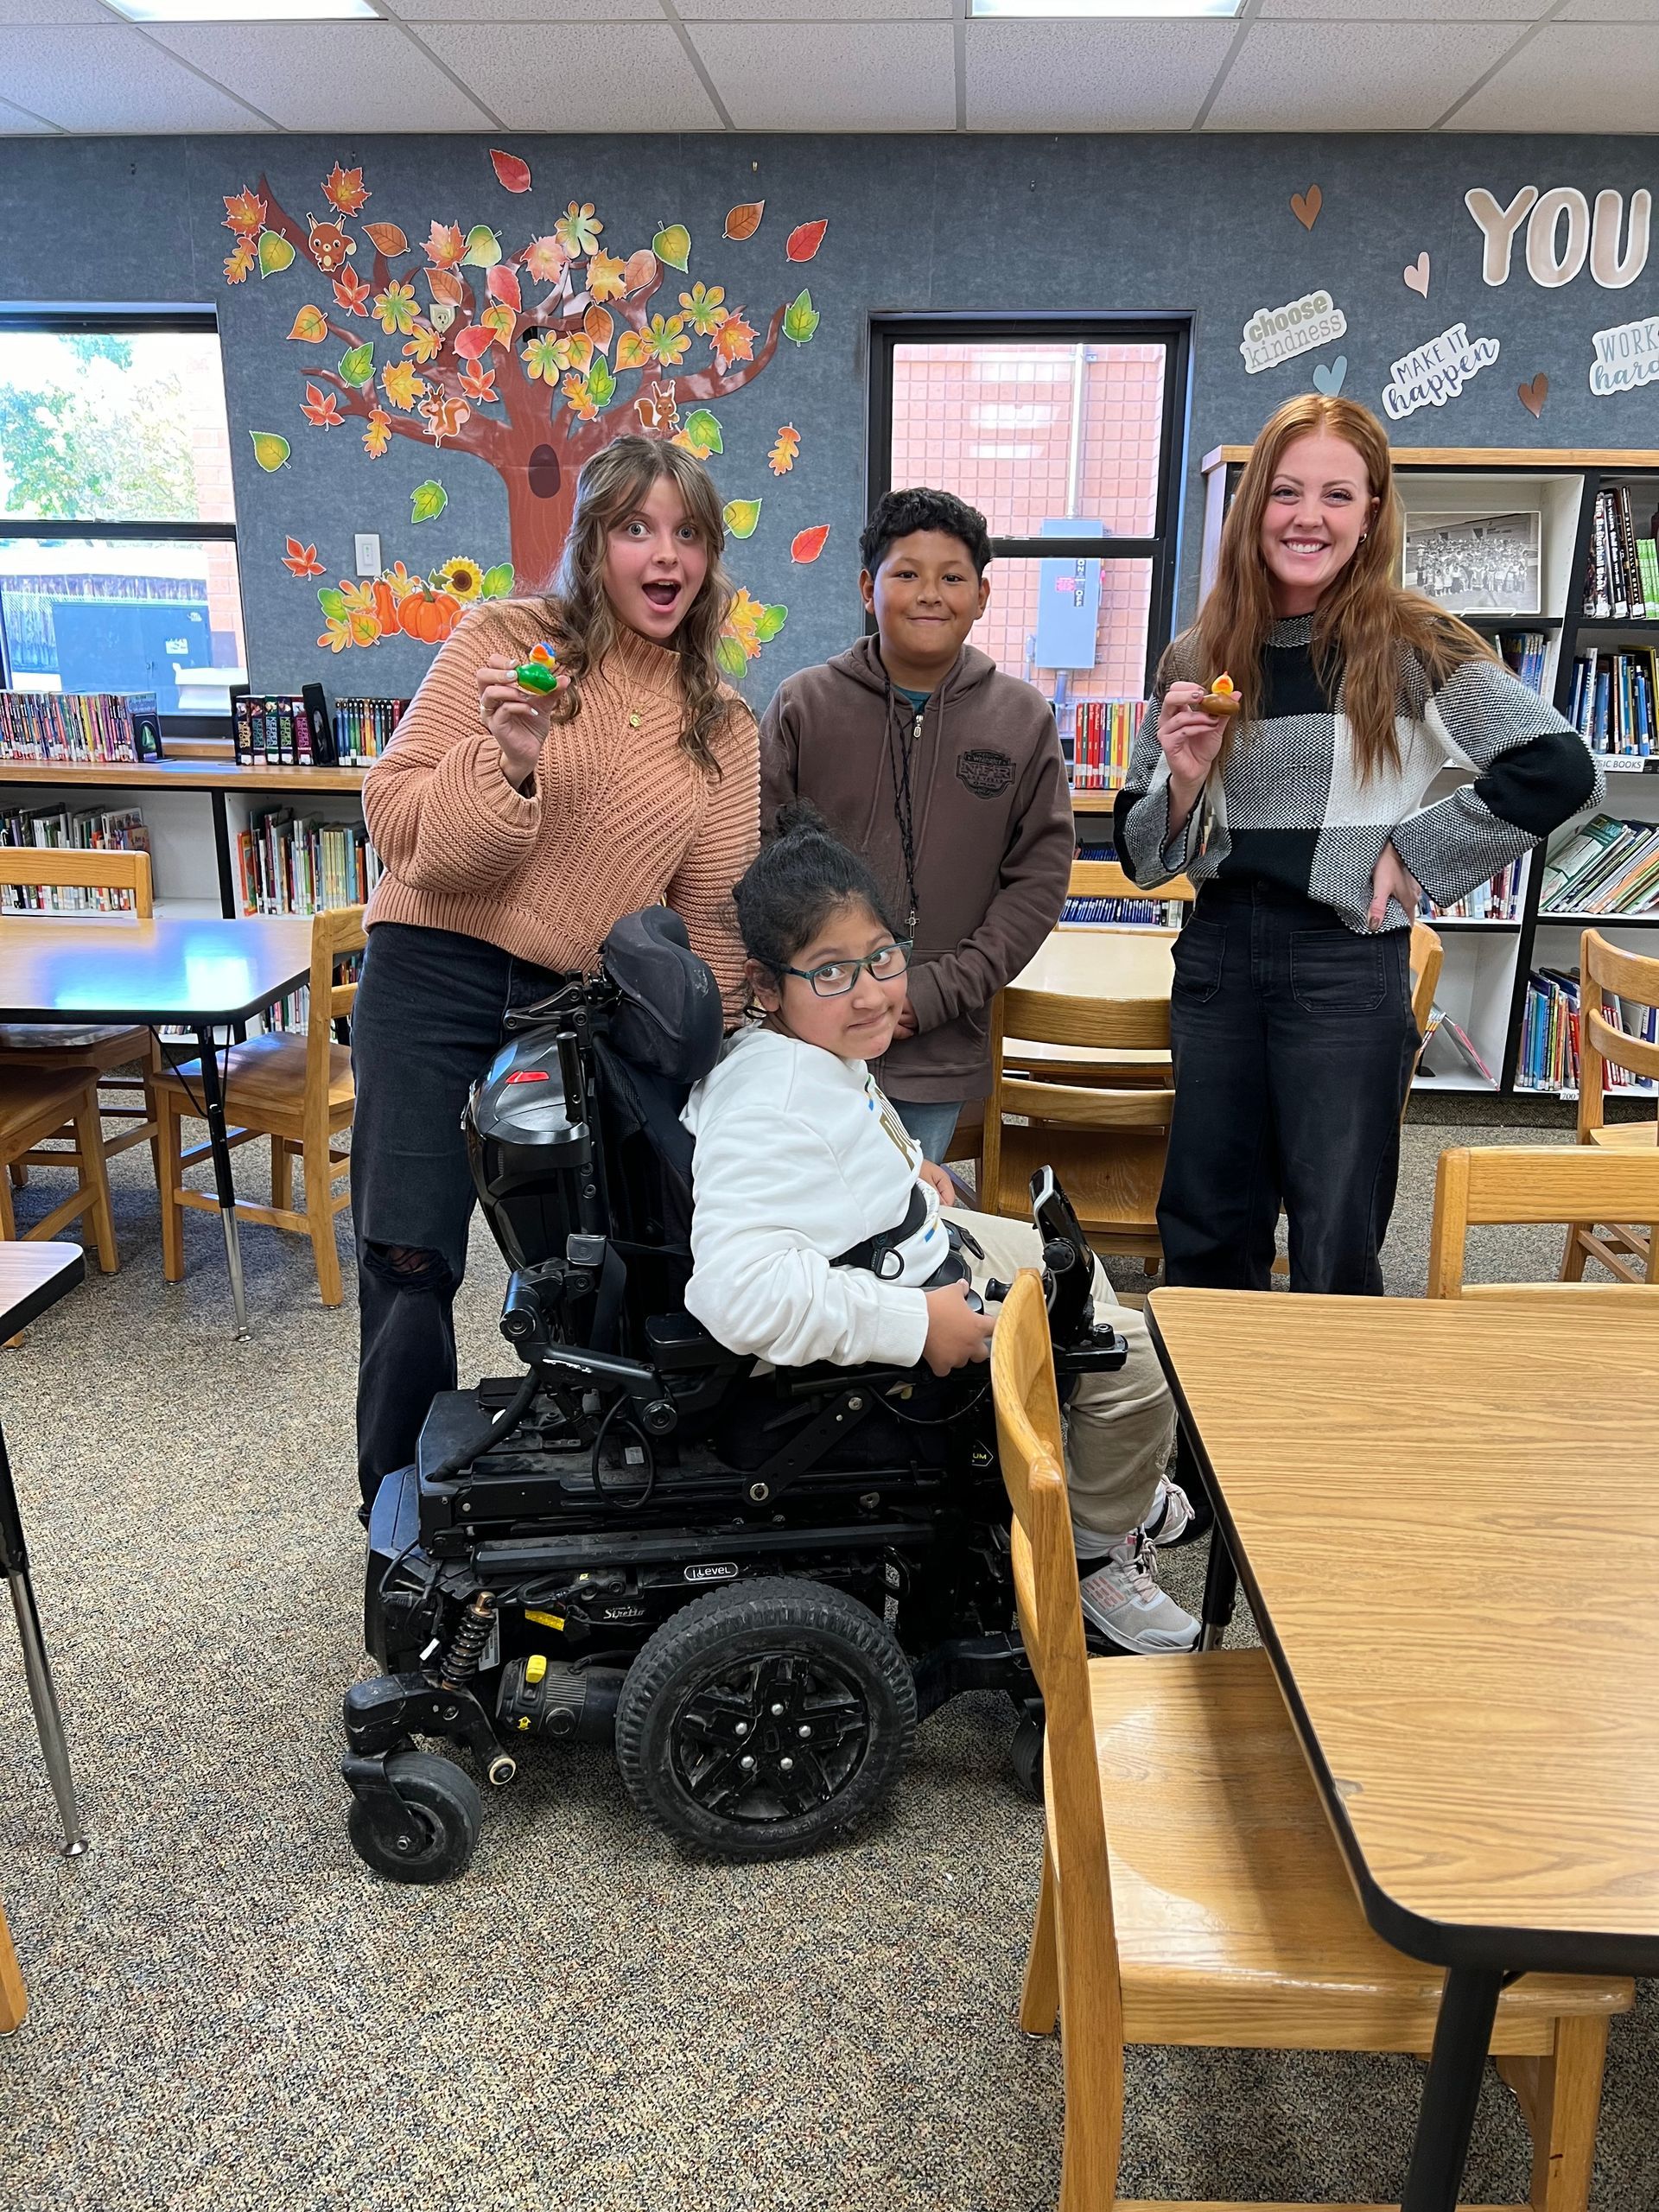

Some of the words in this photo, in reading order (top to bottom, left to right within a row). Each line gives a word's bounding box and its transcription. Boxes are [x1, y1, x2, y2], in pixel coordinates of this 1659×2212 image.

[1465, 186, 1651, 289] YOU
[1246, 315, 1342, 369] kindness
[1249, 296, 1328, 343] choose
[1599, 324, 1658, 363] WORK
[1389, 343, 1496, 413] happen
[1397, 344, 1446, 384] MAKE
[1447, 329, 1464, 353] IT
